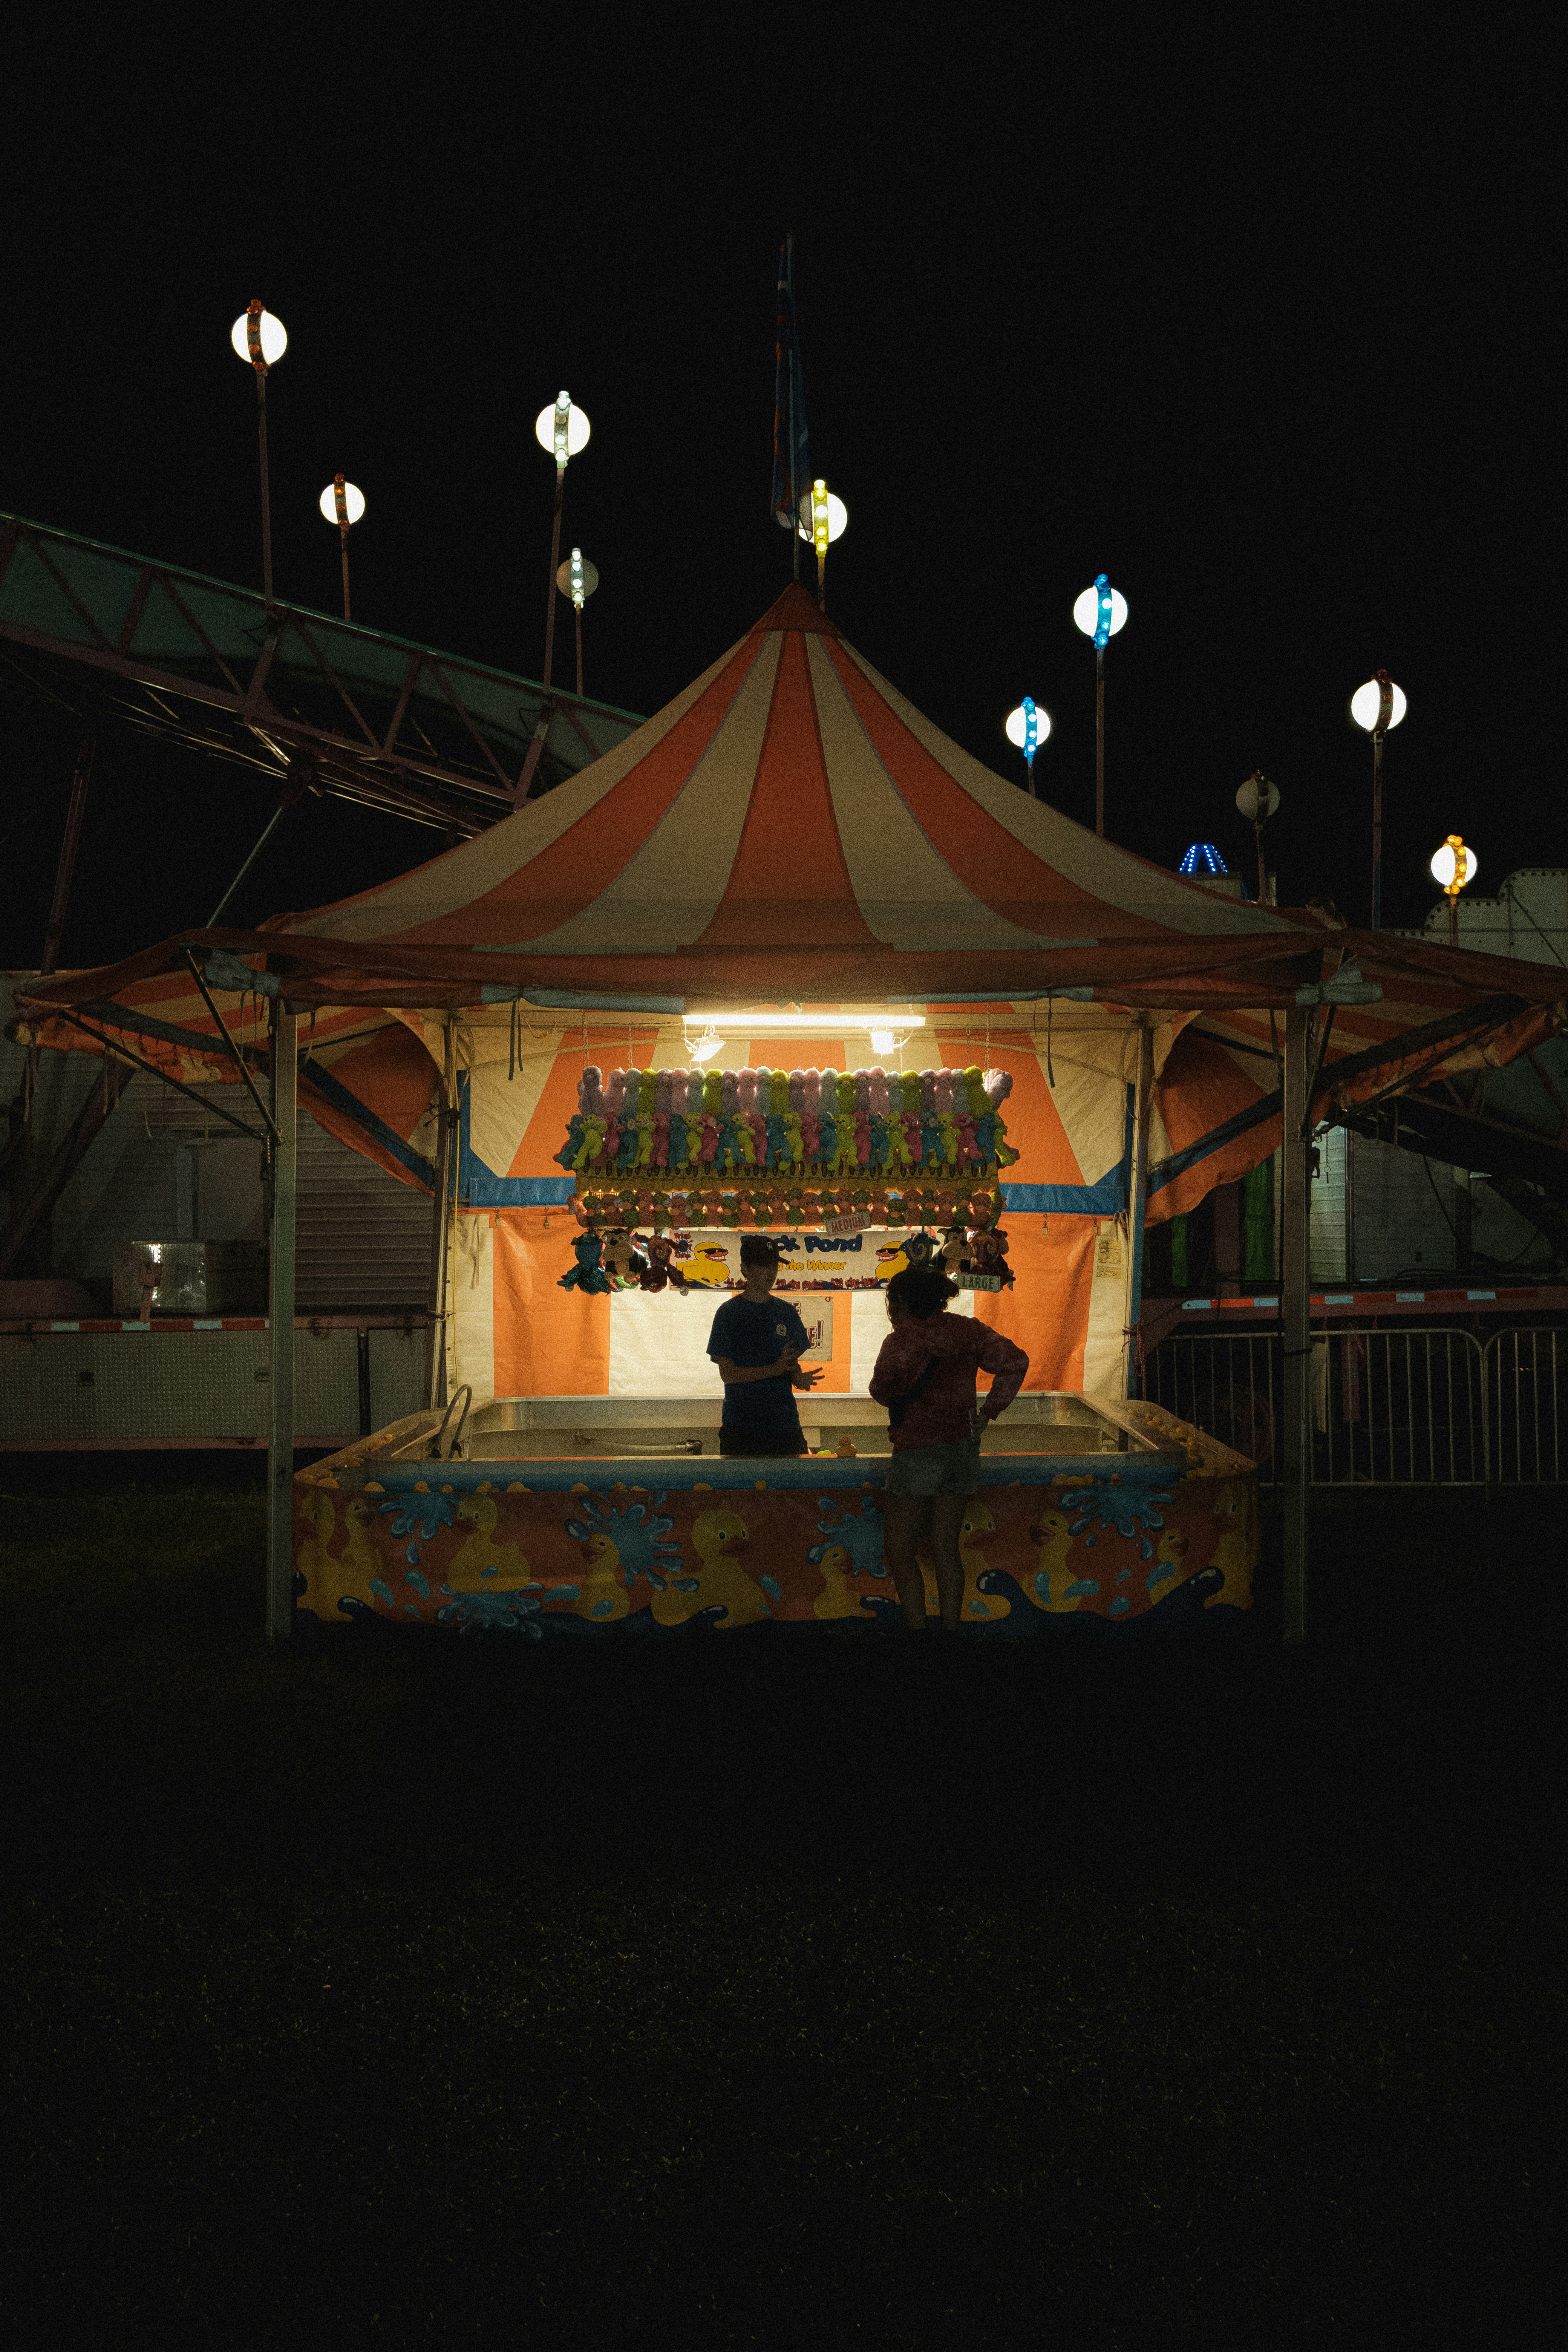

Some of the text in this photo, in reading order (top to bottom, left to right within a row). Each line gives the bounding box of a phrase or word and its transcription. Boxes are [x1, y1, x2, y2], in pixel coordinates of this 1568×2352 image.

[830, 1216, 866, 1233] MEDIUM
[804, 1234, 863, 1253] Pond
[807, 1259, 847, 1271] Winner
[962, 1276, 994, 1289] LARGE
